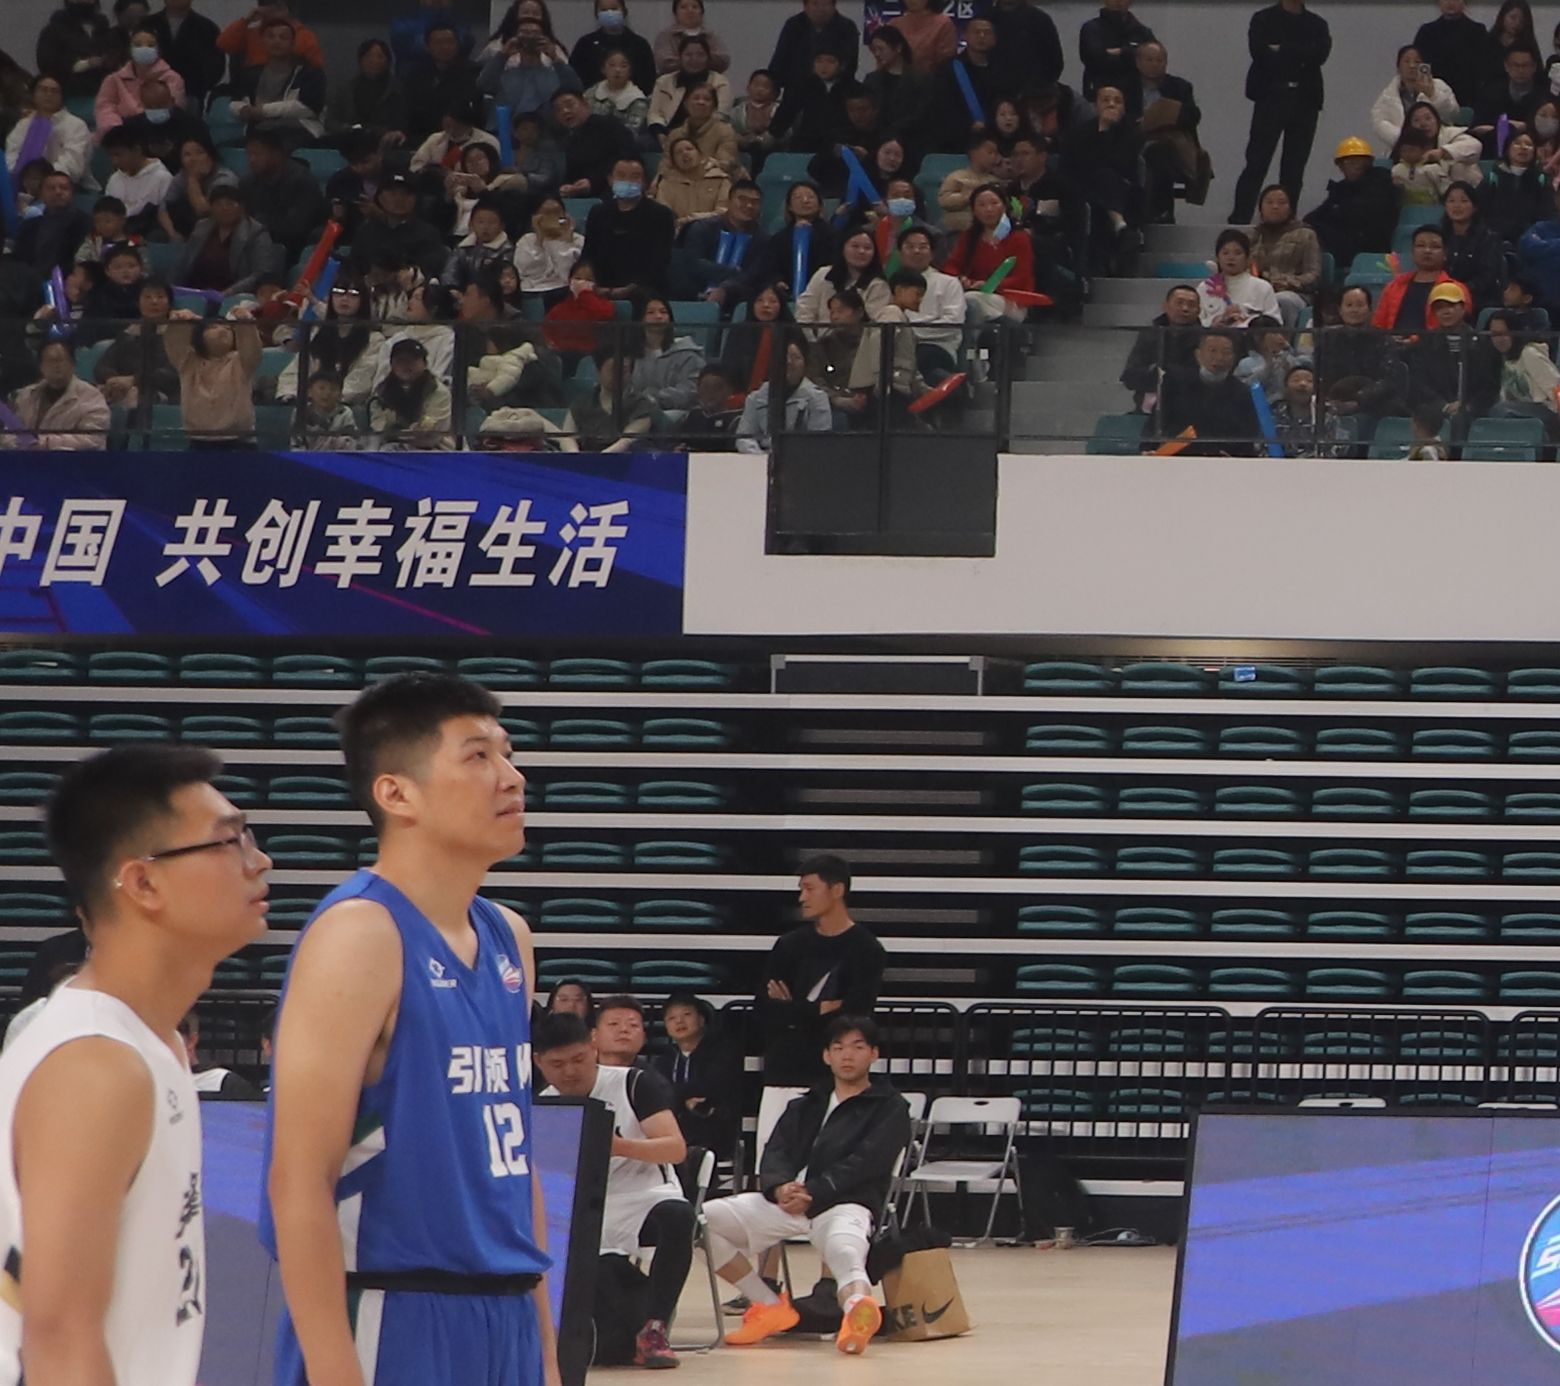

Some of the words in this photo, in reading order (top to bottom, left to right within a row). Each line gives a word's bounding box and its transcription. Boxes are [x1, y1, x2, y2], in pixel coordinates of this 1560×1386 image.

[155, 498, 630, 589] 共创幸福生活
[483, 1102, 540, 1178] 12
